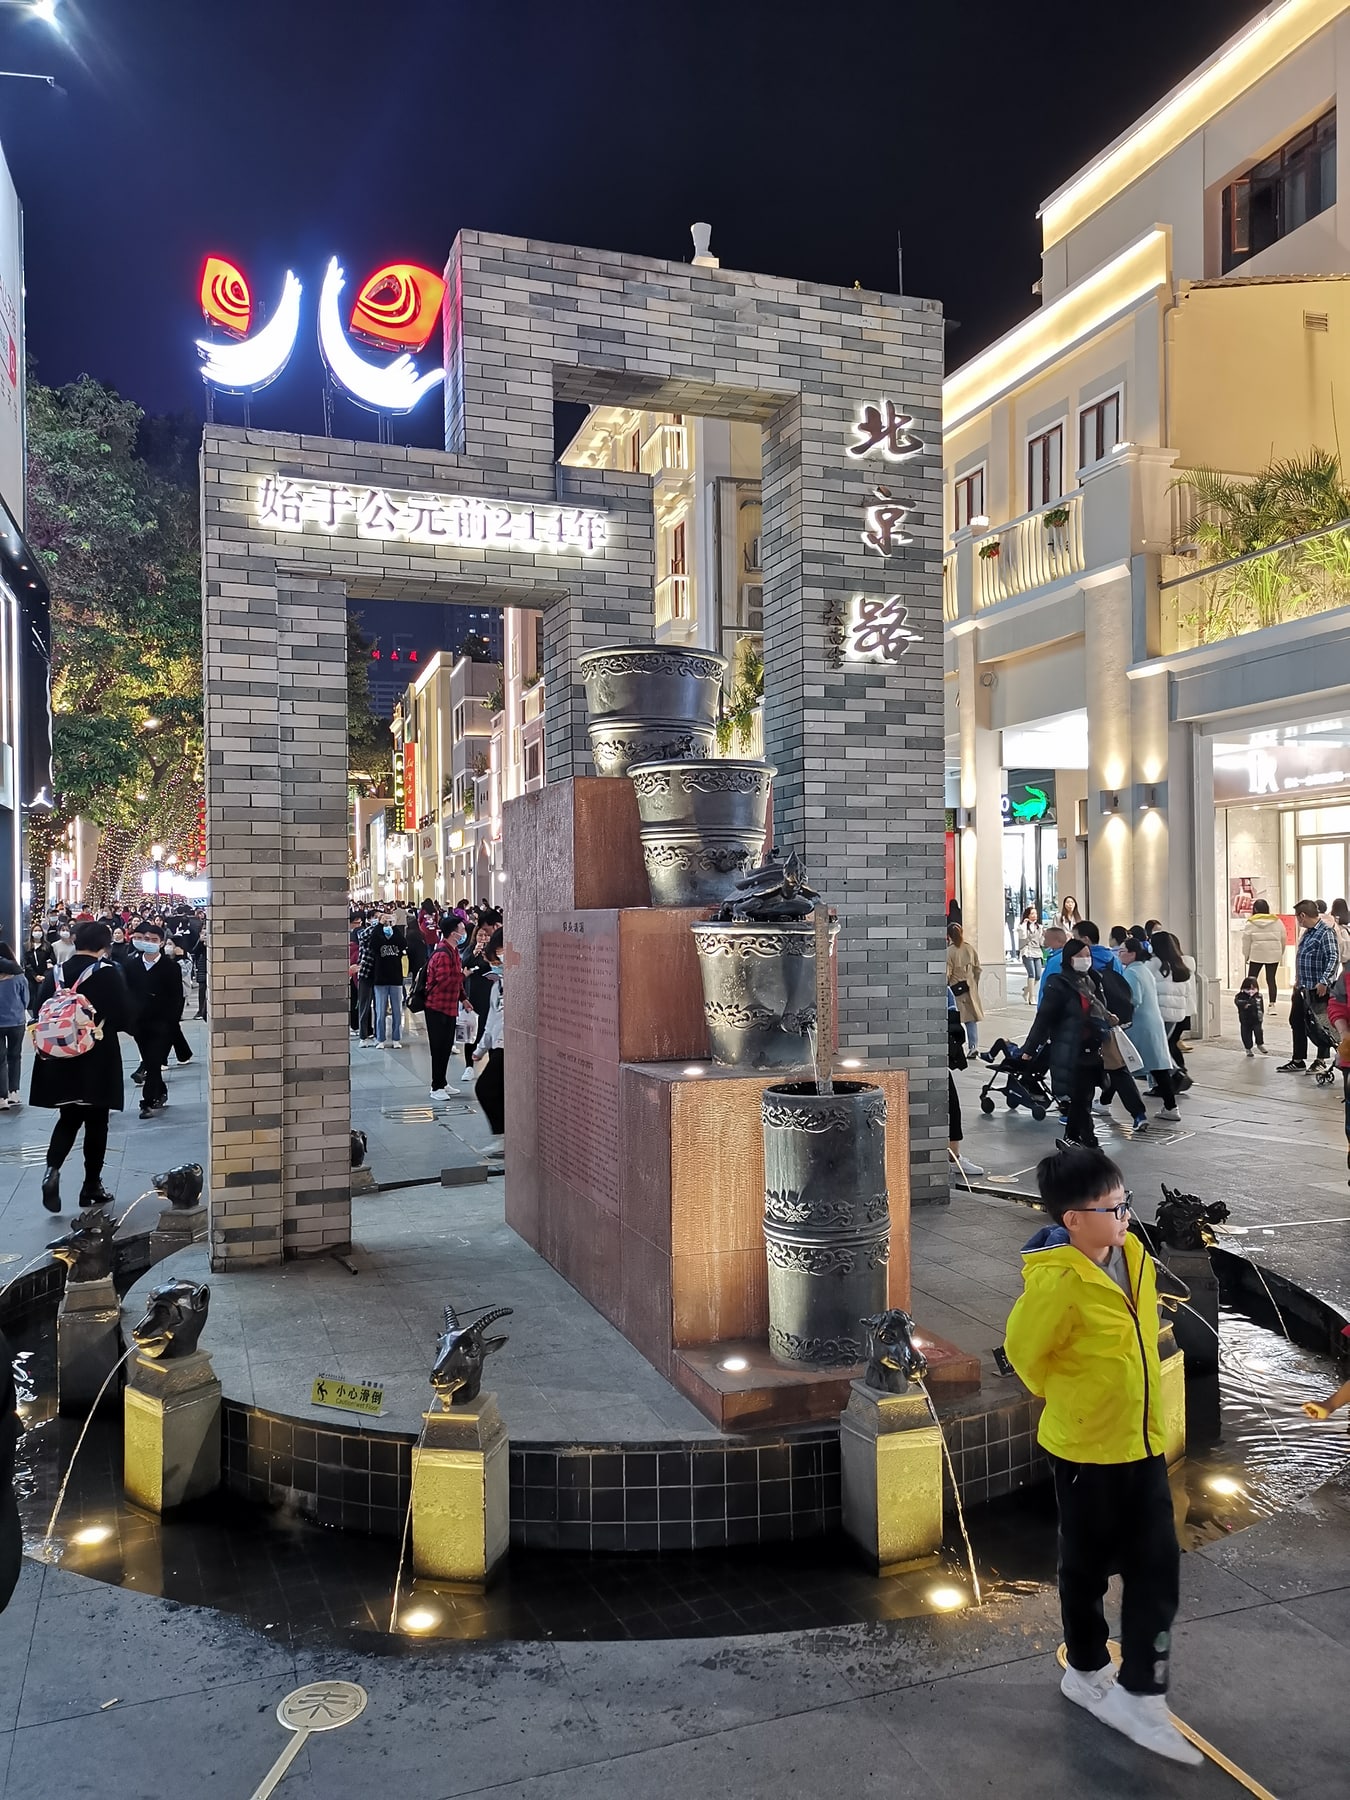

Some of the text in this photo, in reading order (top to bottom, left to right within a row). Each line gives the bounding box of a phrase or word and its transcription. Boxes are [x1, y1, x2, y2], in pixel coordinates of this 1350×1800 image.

[259, 476, 608, 552] 始于公元前214年
[850, 400, 925, 663] 北京路
[336, 1384, 383, 1405] 小心滑倒
